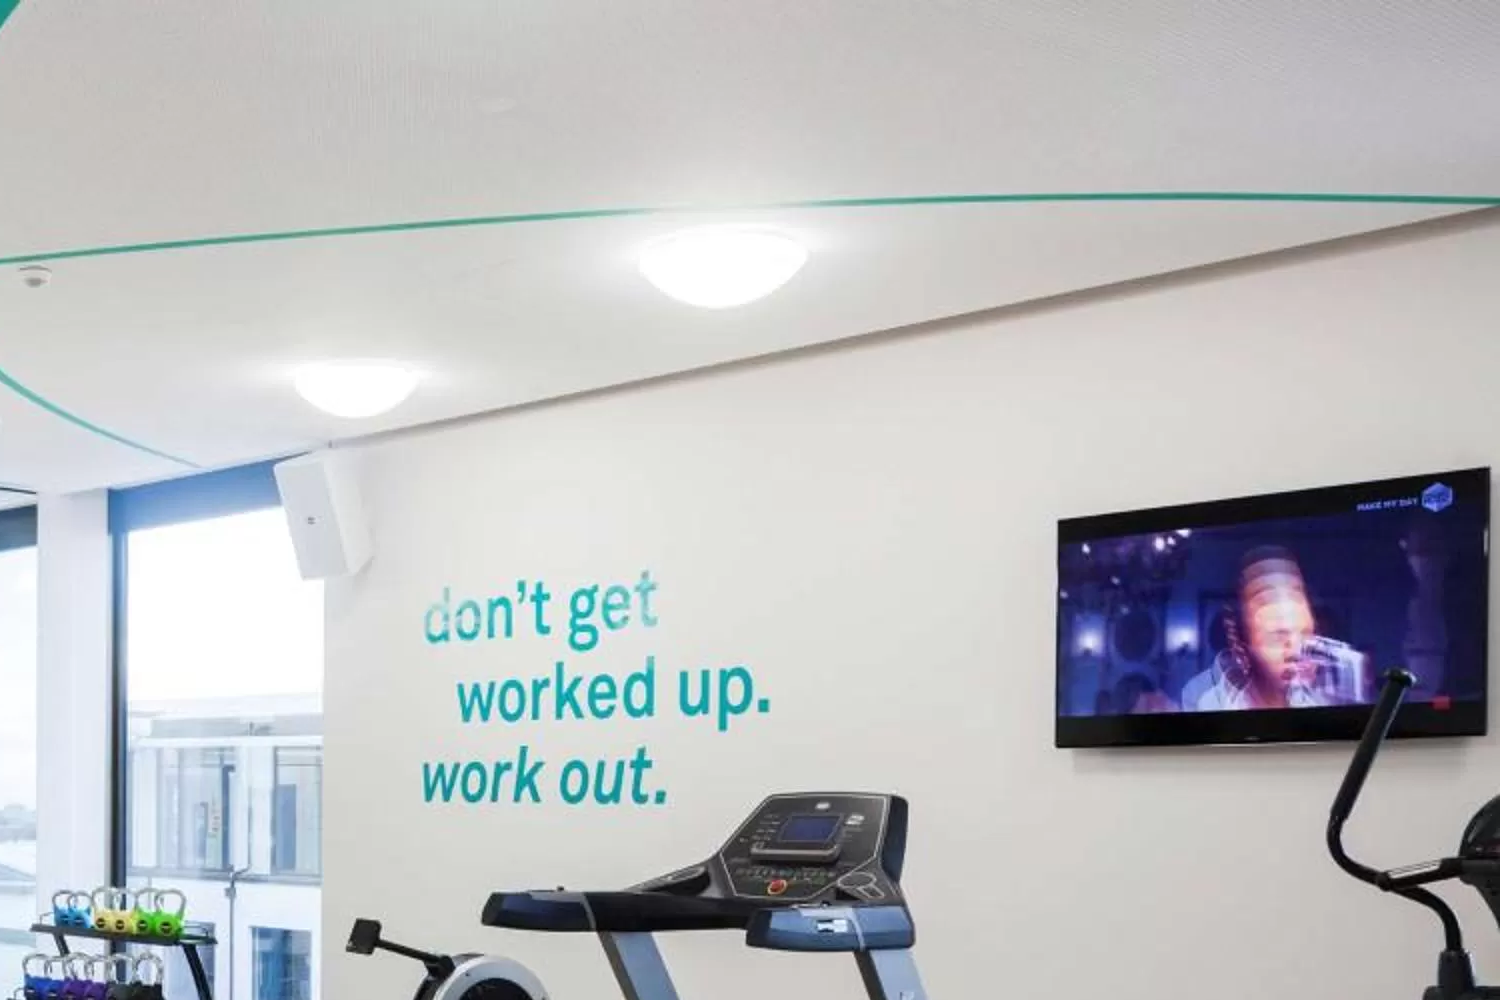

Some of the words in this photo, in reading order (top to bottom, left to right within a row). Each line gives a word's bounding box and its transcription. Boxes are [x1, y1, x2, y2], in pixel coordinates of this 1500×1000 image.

[424, 580, 551, 643] don't
[568, 570, 658, 652] get
[457, 656, 655, 722] worked
[679, 664, 770, 731] up.
[422, 746, 545, 803] work
[560, 746, 666, 805] out.
